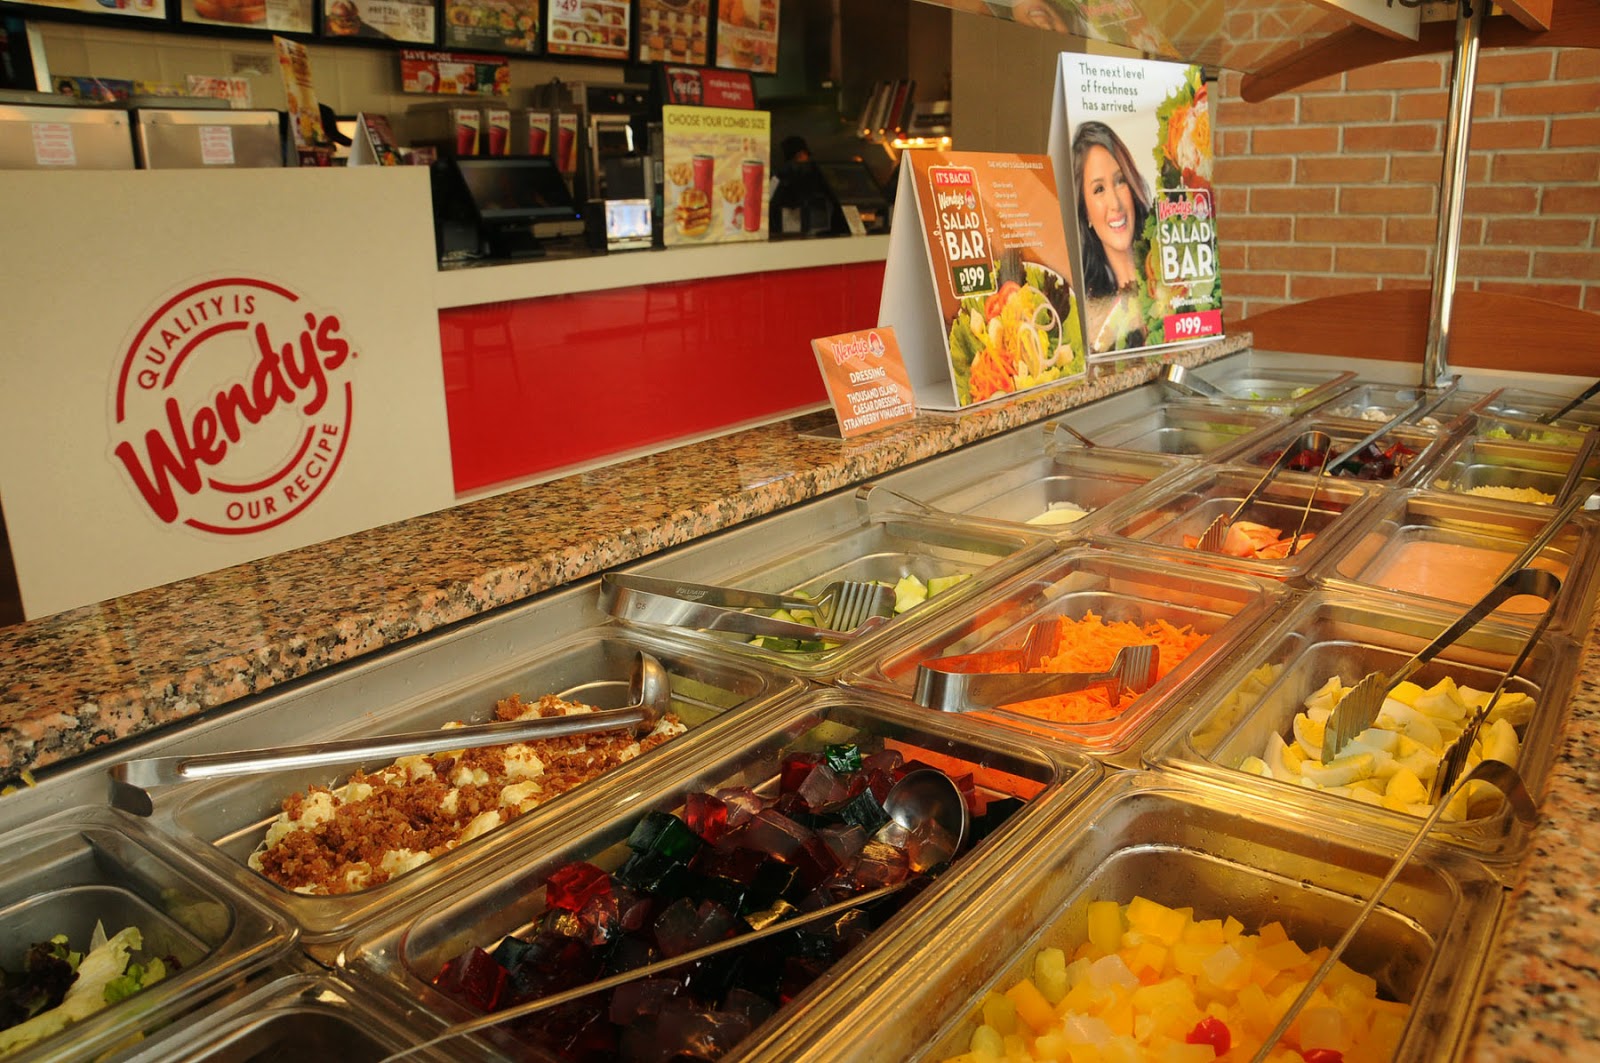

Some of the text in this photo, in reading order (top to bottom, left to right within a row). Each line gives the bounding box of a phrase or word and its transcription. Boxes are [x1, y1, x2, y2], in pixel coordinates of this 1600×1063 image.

[1078, 62, 1145, 80] The next level
[1081, 80, 1138, 96] of freshness
[1082, 97, 1137, 113] has arrived.
[668, 113, 765, 129] CHOOSE YOUR COMBO SIZE
[935, 172, 971, 185] IT'S BACK!
[938, 189, 965, 211] Wendy's
[1159, 194, 1192, 221] Wendy's
[942, 211, 980, 231] SALAD
[1161, 222, 1210, 244] SALAD
[945, 230, 987, 261] BAR
[1162, 243, 1214, 280] BAR
[137, 294, 256, 391] QUALITY IS
[831, 334, 869, 366] Wendy's
[849, 366, 886, 383] DRESSING
[847, 383, 898, 404] THOUSAND ISLAND
[853, 395, 901, 415] CAESAR DRESSING
[114, 311, 350, 524] Wendy's
[843, 402, 913, 431] STRAWBERRY VINAIGRETTE
[226, 423, 339, 521] OUR RECIPE
